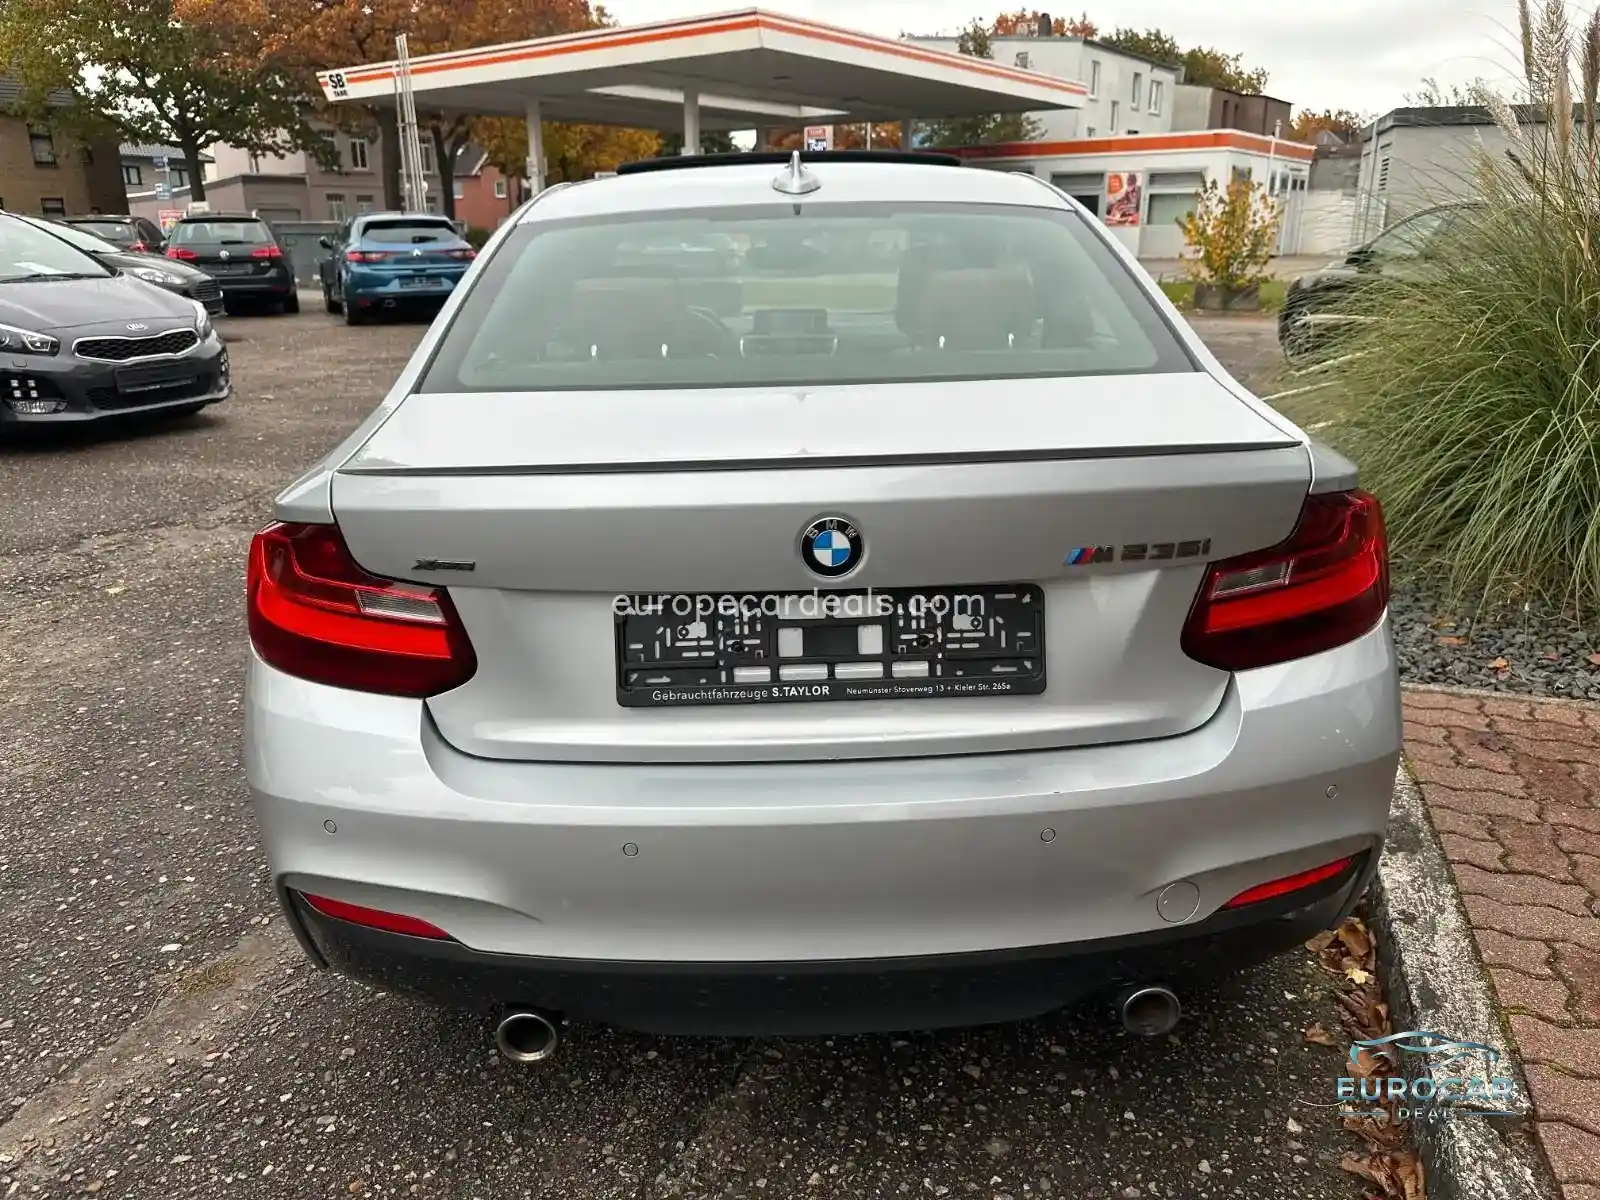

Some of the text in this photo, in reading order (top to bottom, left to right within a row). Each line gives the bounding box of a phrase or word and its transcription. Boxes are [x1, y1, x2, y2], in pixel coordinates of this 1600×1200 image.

[329, 74, 345, 89] SB
[807, 519, 857, 539] BMW
[652, 685, 830, 702] Gebrauchtfahrzeuge S.TAYLOR
[846, 686, 892, 695] Neumünster
[935, 684, 945, 692] 13
[954, 684, 977, 692] Kieler
[978, 683, 991, 691] Str.
